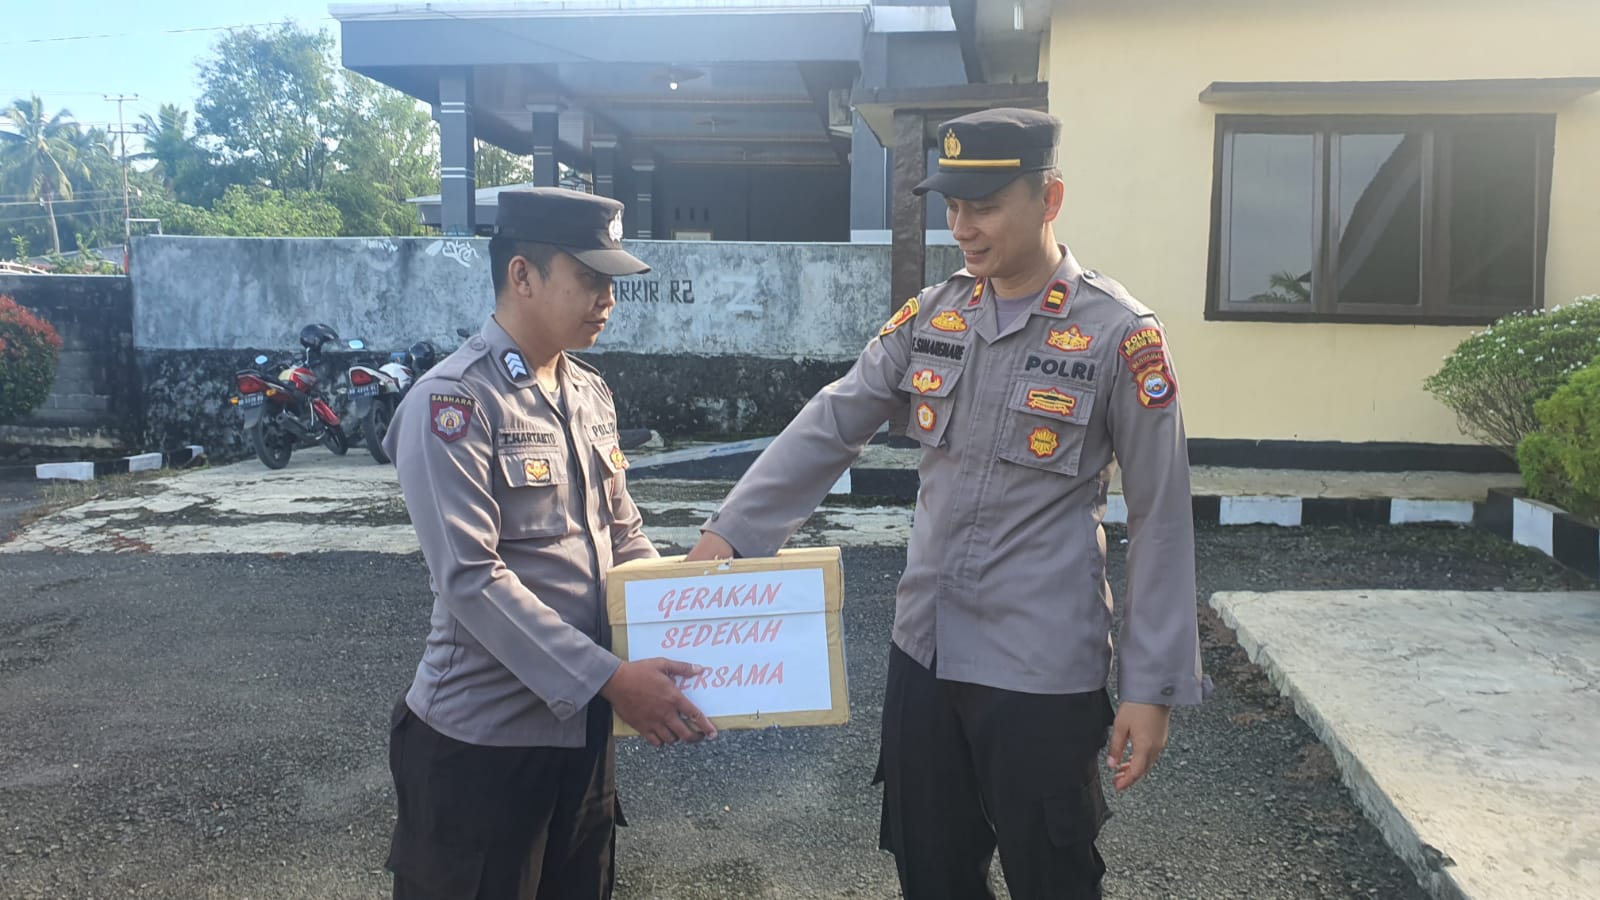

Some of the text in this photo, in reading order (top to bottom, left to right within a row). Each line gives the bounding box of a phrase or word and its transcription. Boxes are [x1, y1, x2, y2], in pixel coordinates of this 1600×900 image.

[611, 280, 695, 304] ARKIR R2
[1025, 356, 1095, 381] POLRI
[431, 394, 472, 406] SABHARA
[657, 582, 783, 619] GERAKAN
[660, 619, 783, 649] SEDEKAH
[679, 661, 784, 690] ERSAMA
